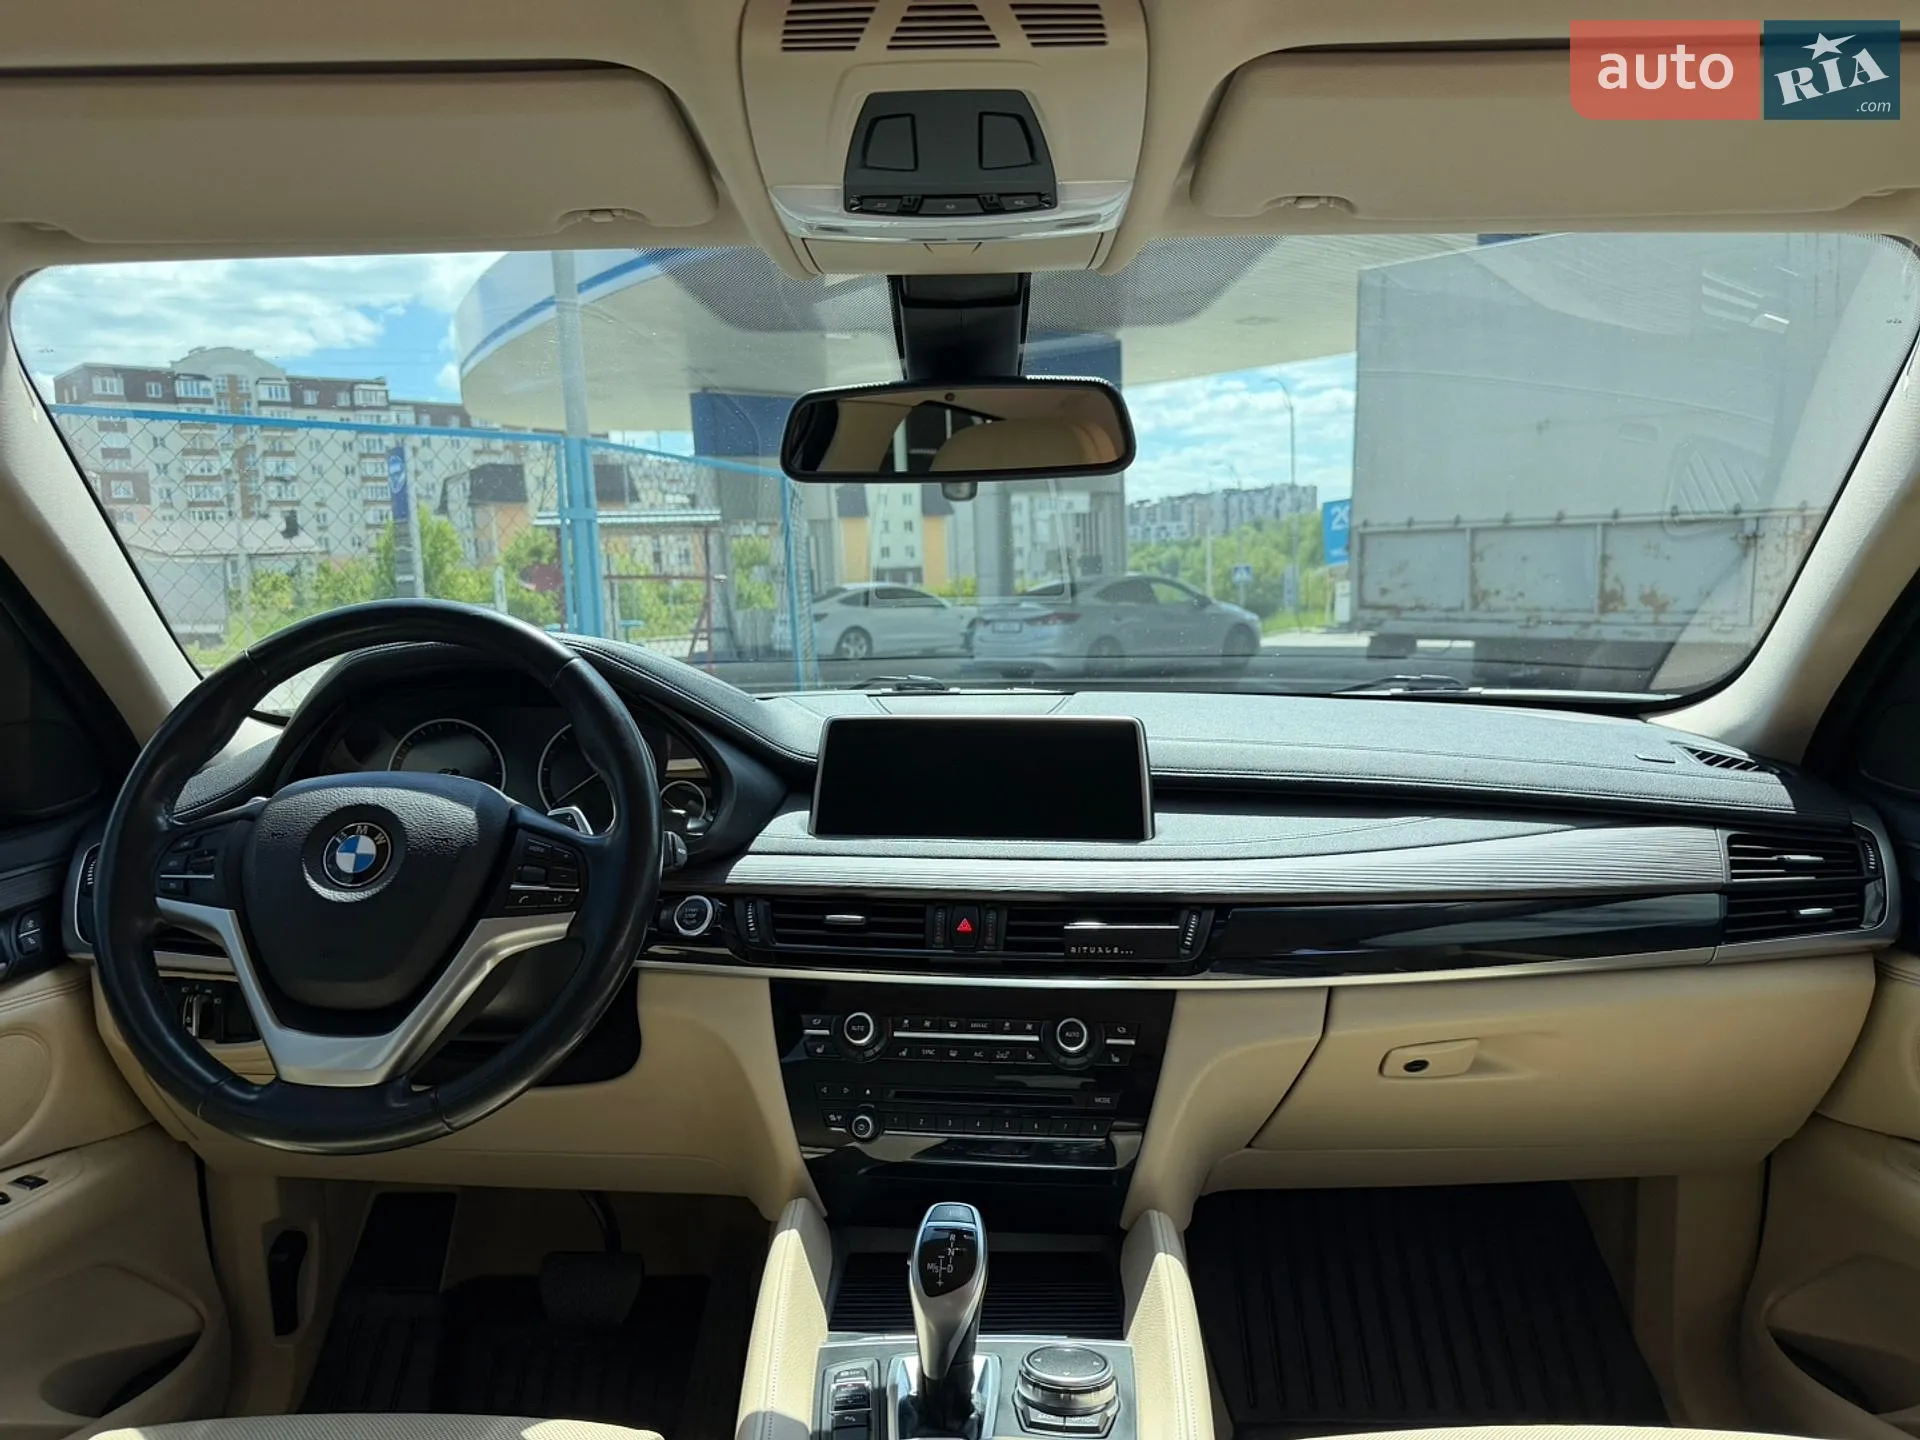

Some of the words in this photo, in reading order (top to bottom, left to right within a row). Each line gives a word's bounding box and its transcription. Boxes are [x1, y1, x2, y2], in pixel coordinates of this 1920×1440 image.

[335, 825, 387, 846] BMW
[947, 1247, 955, 1256] N
[946, 1264, 954, 1273] D
